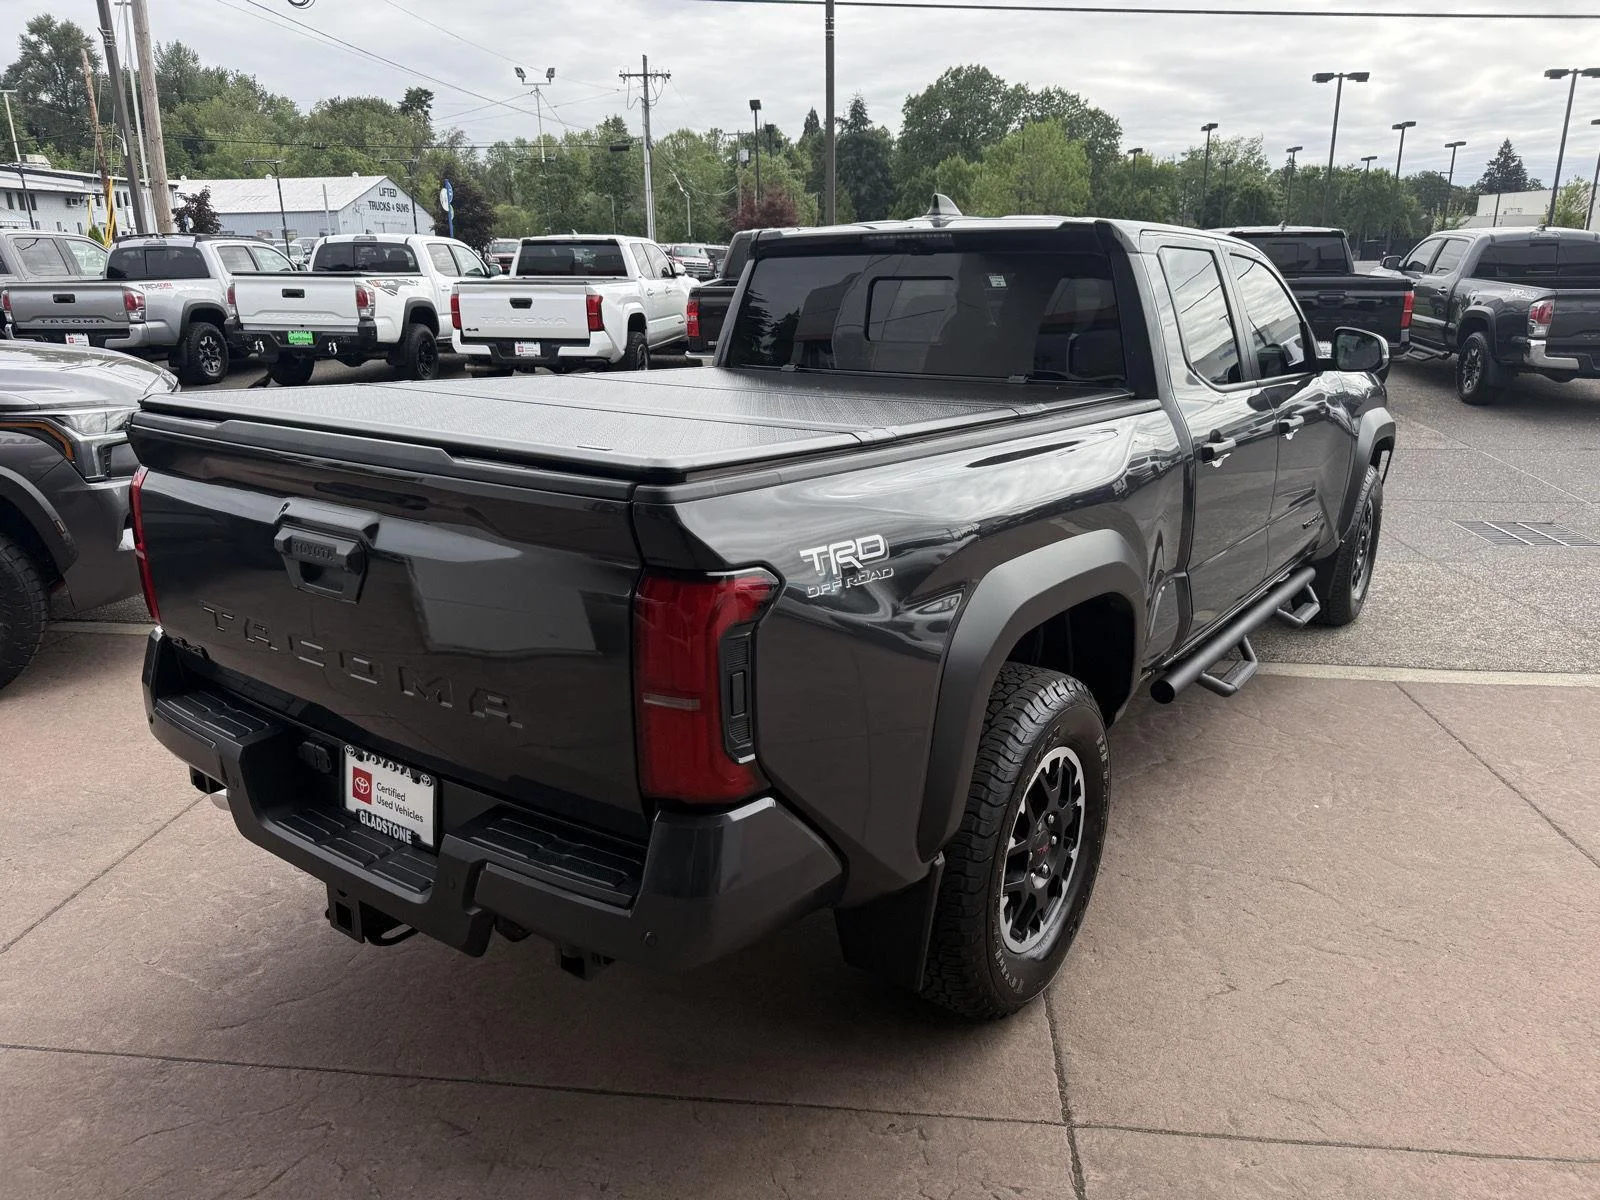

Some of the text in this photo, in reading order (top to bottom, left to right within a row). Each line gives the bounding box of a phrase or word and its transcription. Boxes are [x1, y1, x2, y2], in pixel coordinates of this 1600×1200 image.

[368, 200, 390, 212] TRUCKS
[379, 187, 397, 198] LIFTED
[799, 534, 889, 576] TRD
[807, 567, 894, 598] OFF ROAD
[201, 601, 524, 729] TACOMA
[362, 751, 413, 781] TOYOTA
[376, 782, 406, 802] Certified
[376, 795, 424, 823] Used Vehicles
[359, 810, 412, 844] GLADSTONE
